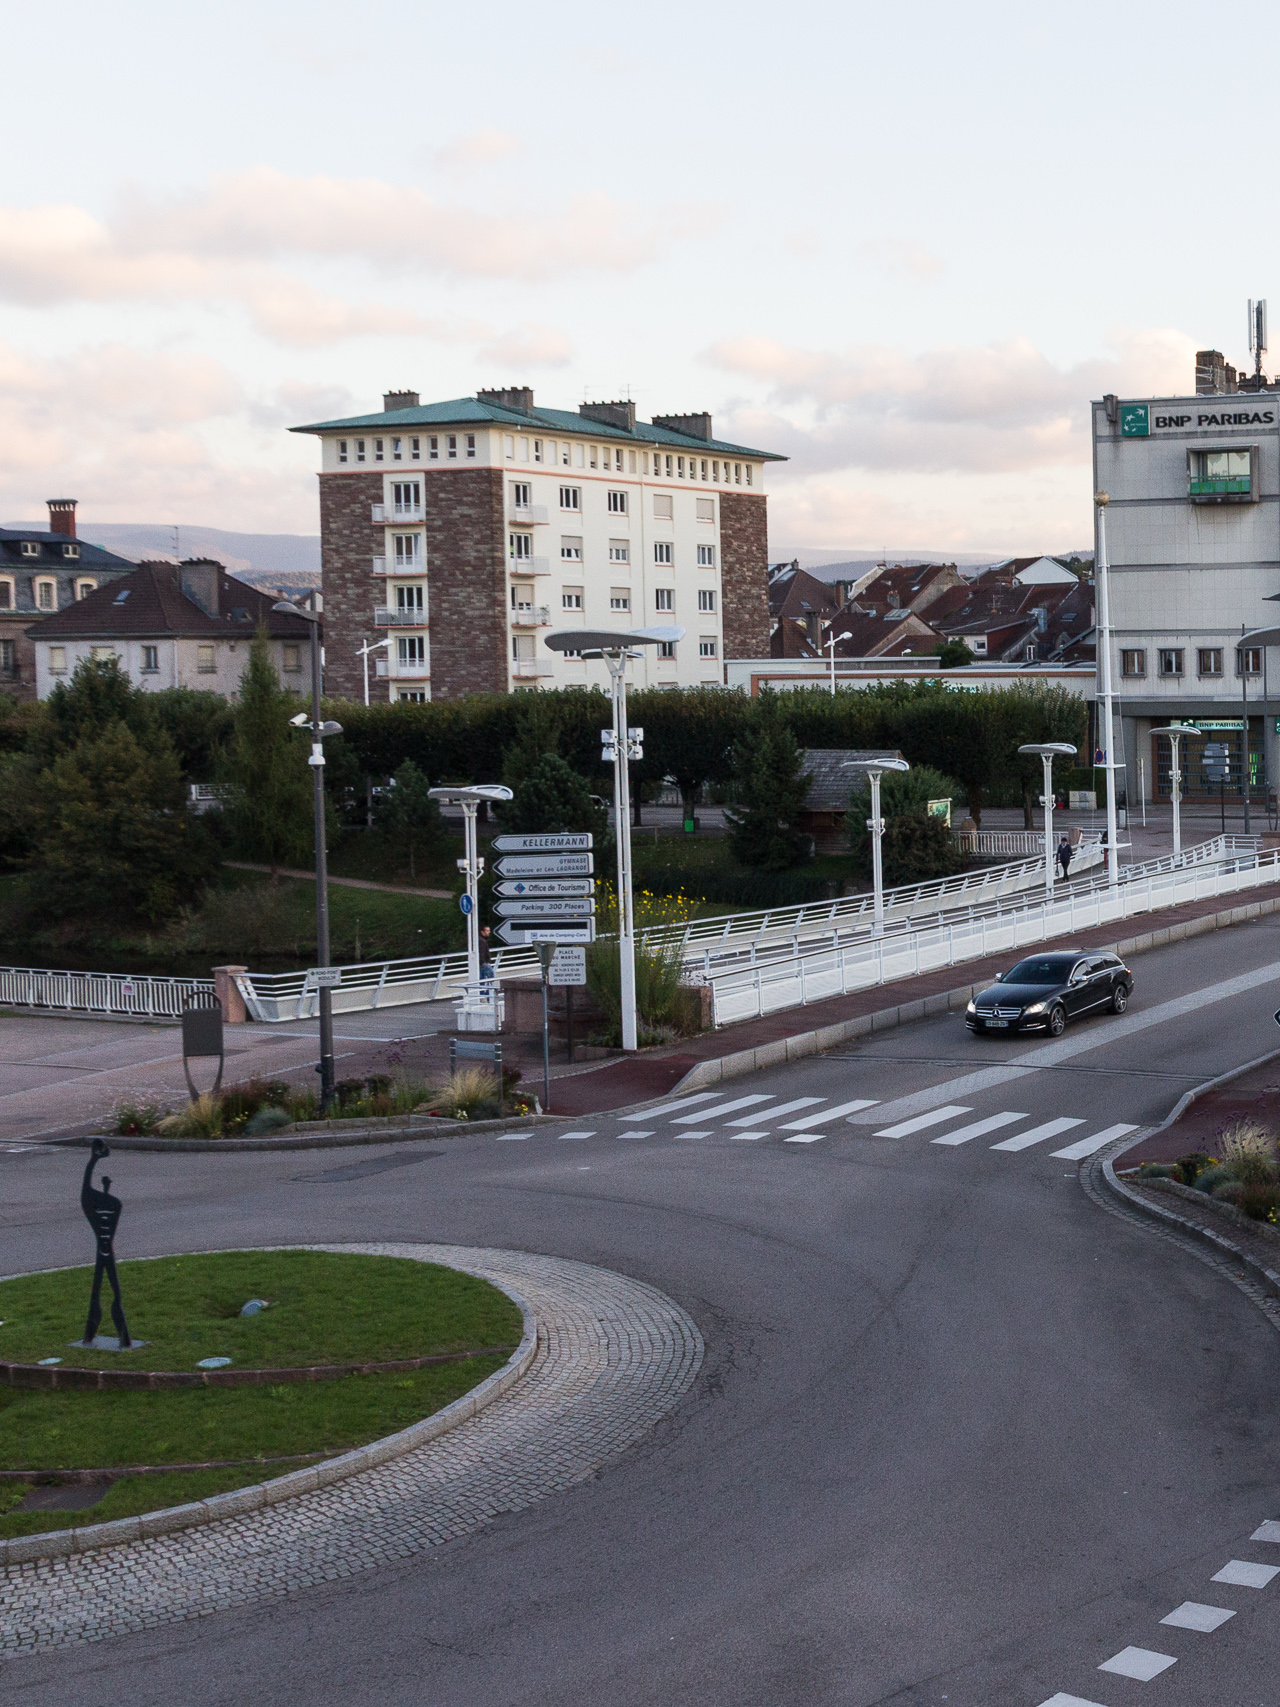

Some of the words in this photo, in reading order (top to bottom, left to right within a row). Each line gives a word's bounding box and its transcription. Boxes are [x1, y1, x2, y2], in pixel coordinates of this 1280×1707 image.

[1155, 415, 1192, 428] BNP
[1197, 411, 1274, 426] PARIBAS
[522, 837, 585, 847] KELLERMANN
[559, 857, 587, 865] GYMNASE
[528, 884, 547, 892] Office
[547, 884, 555, 892] de
[557, 883, 586, 891] Tourisme
[521, 904, 545, 912] Parking
